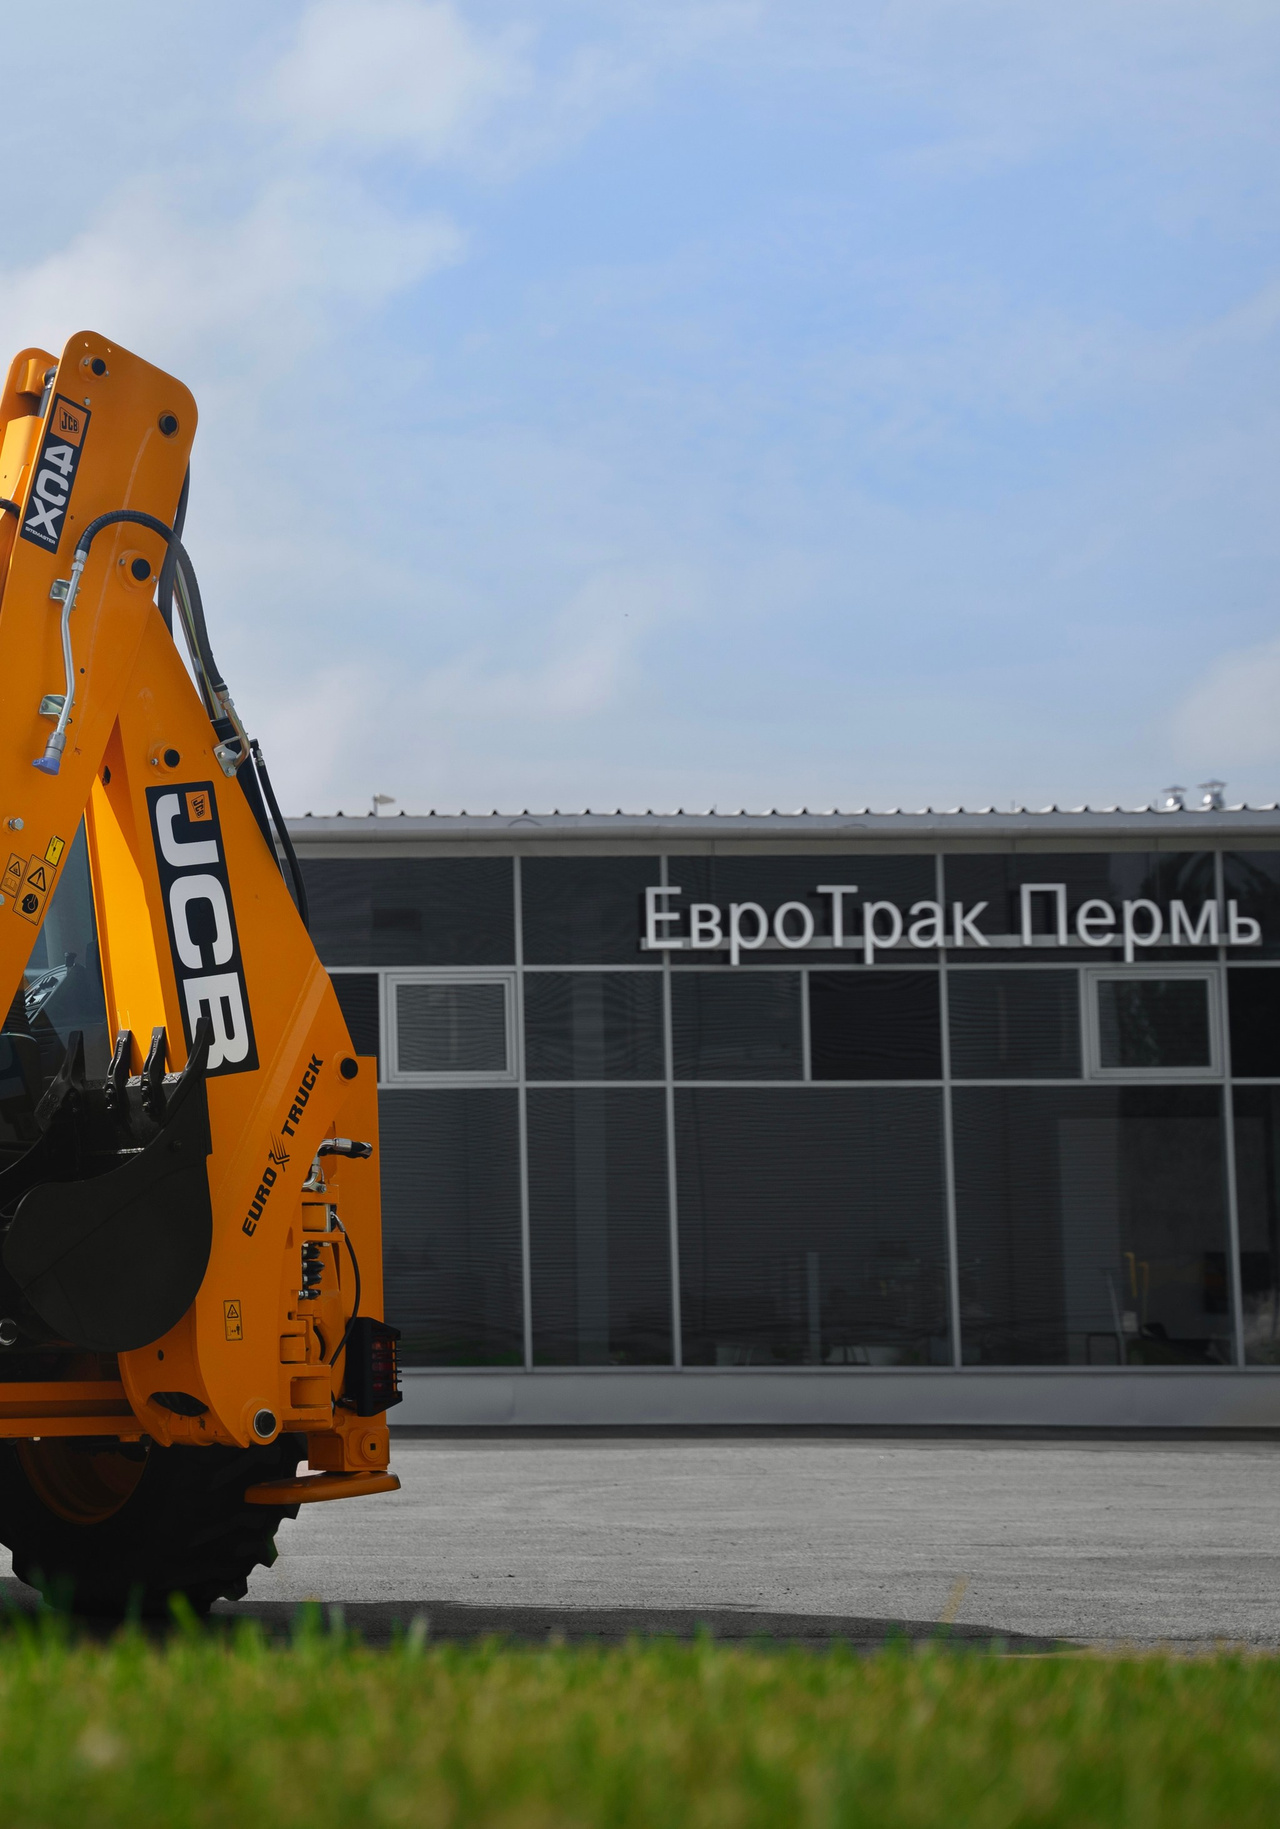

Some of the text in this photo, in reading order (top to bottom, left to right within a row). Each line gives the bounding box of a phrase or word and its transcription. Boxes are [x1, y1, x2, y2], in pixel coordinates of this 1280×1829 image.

[61, 410, 79, 432] JCB
[25, 444, 74, 539] 4CX
[25, 526, 56, 545] SITEMASTER
[155, 793, 249, 1070] JCB
[644, 883, 1262, 966] ЕвроТрак Пермь
[241, 1053, 324, 1237] EURO TRUCK
